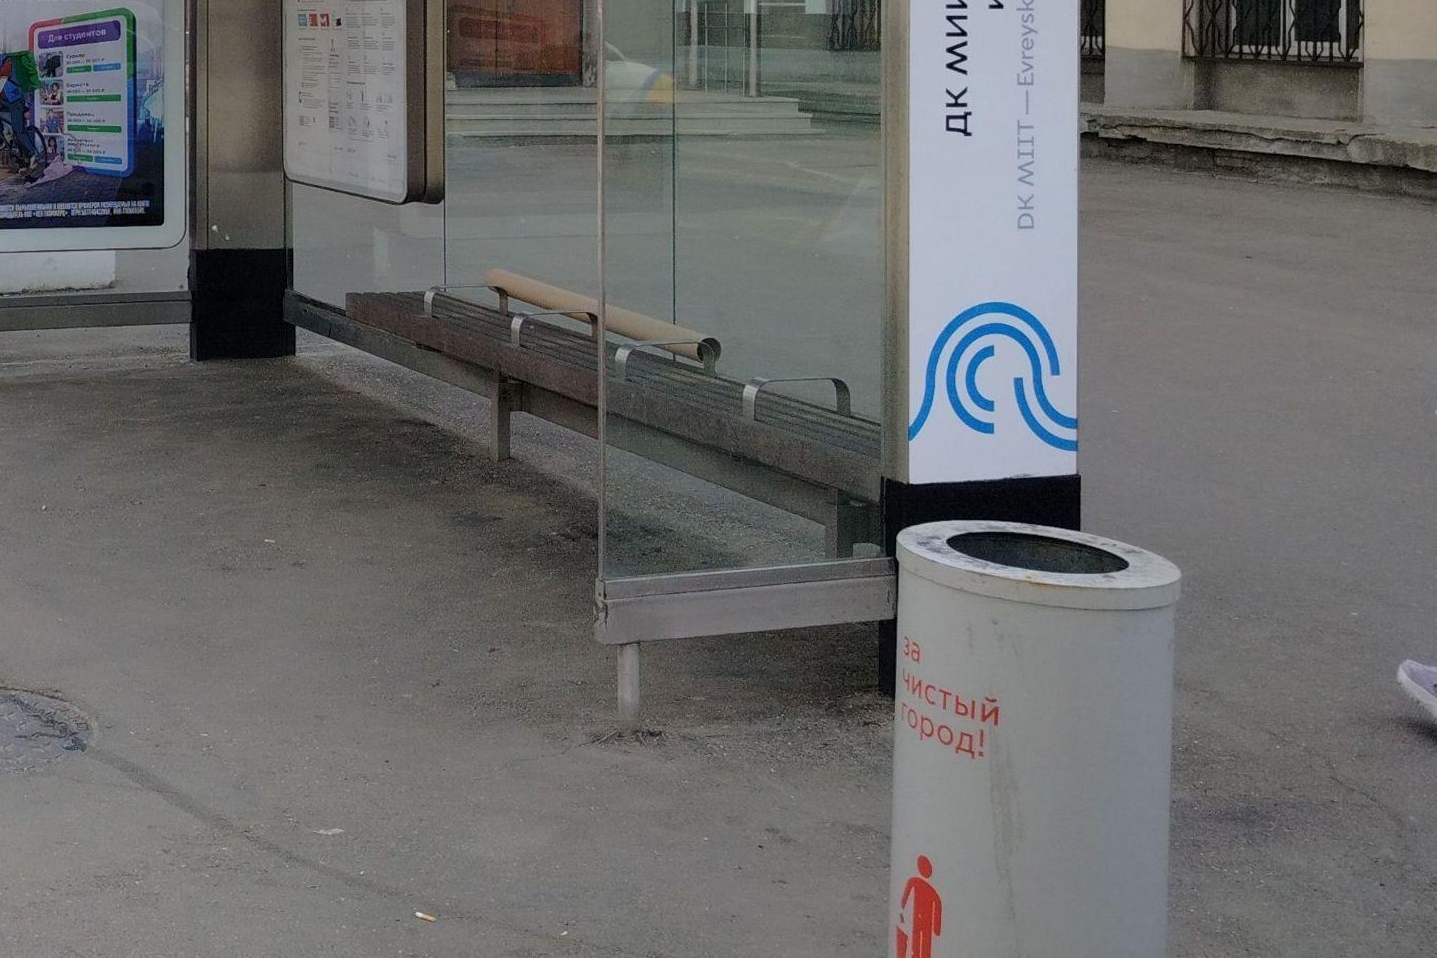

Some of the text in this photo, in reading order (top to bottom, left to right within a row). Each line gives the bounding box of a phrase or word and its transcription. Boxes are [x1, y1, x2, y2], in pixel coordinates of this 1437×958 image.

[63, 28, 107, 42] студентов
[945, 86, 972, 137] ДК
[1016, 119, 1035, 186] MIIT
[1017, 194, 1035, 229] DK
[903, 636, 921, 664] за
[902, 667, 1000, 726] чистый
[901, 702, 984, 760] город!
